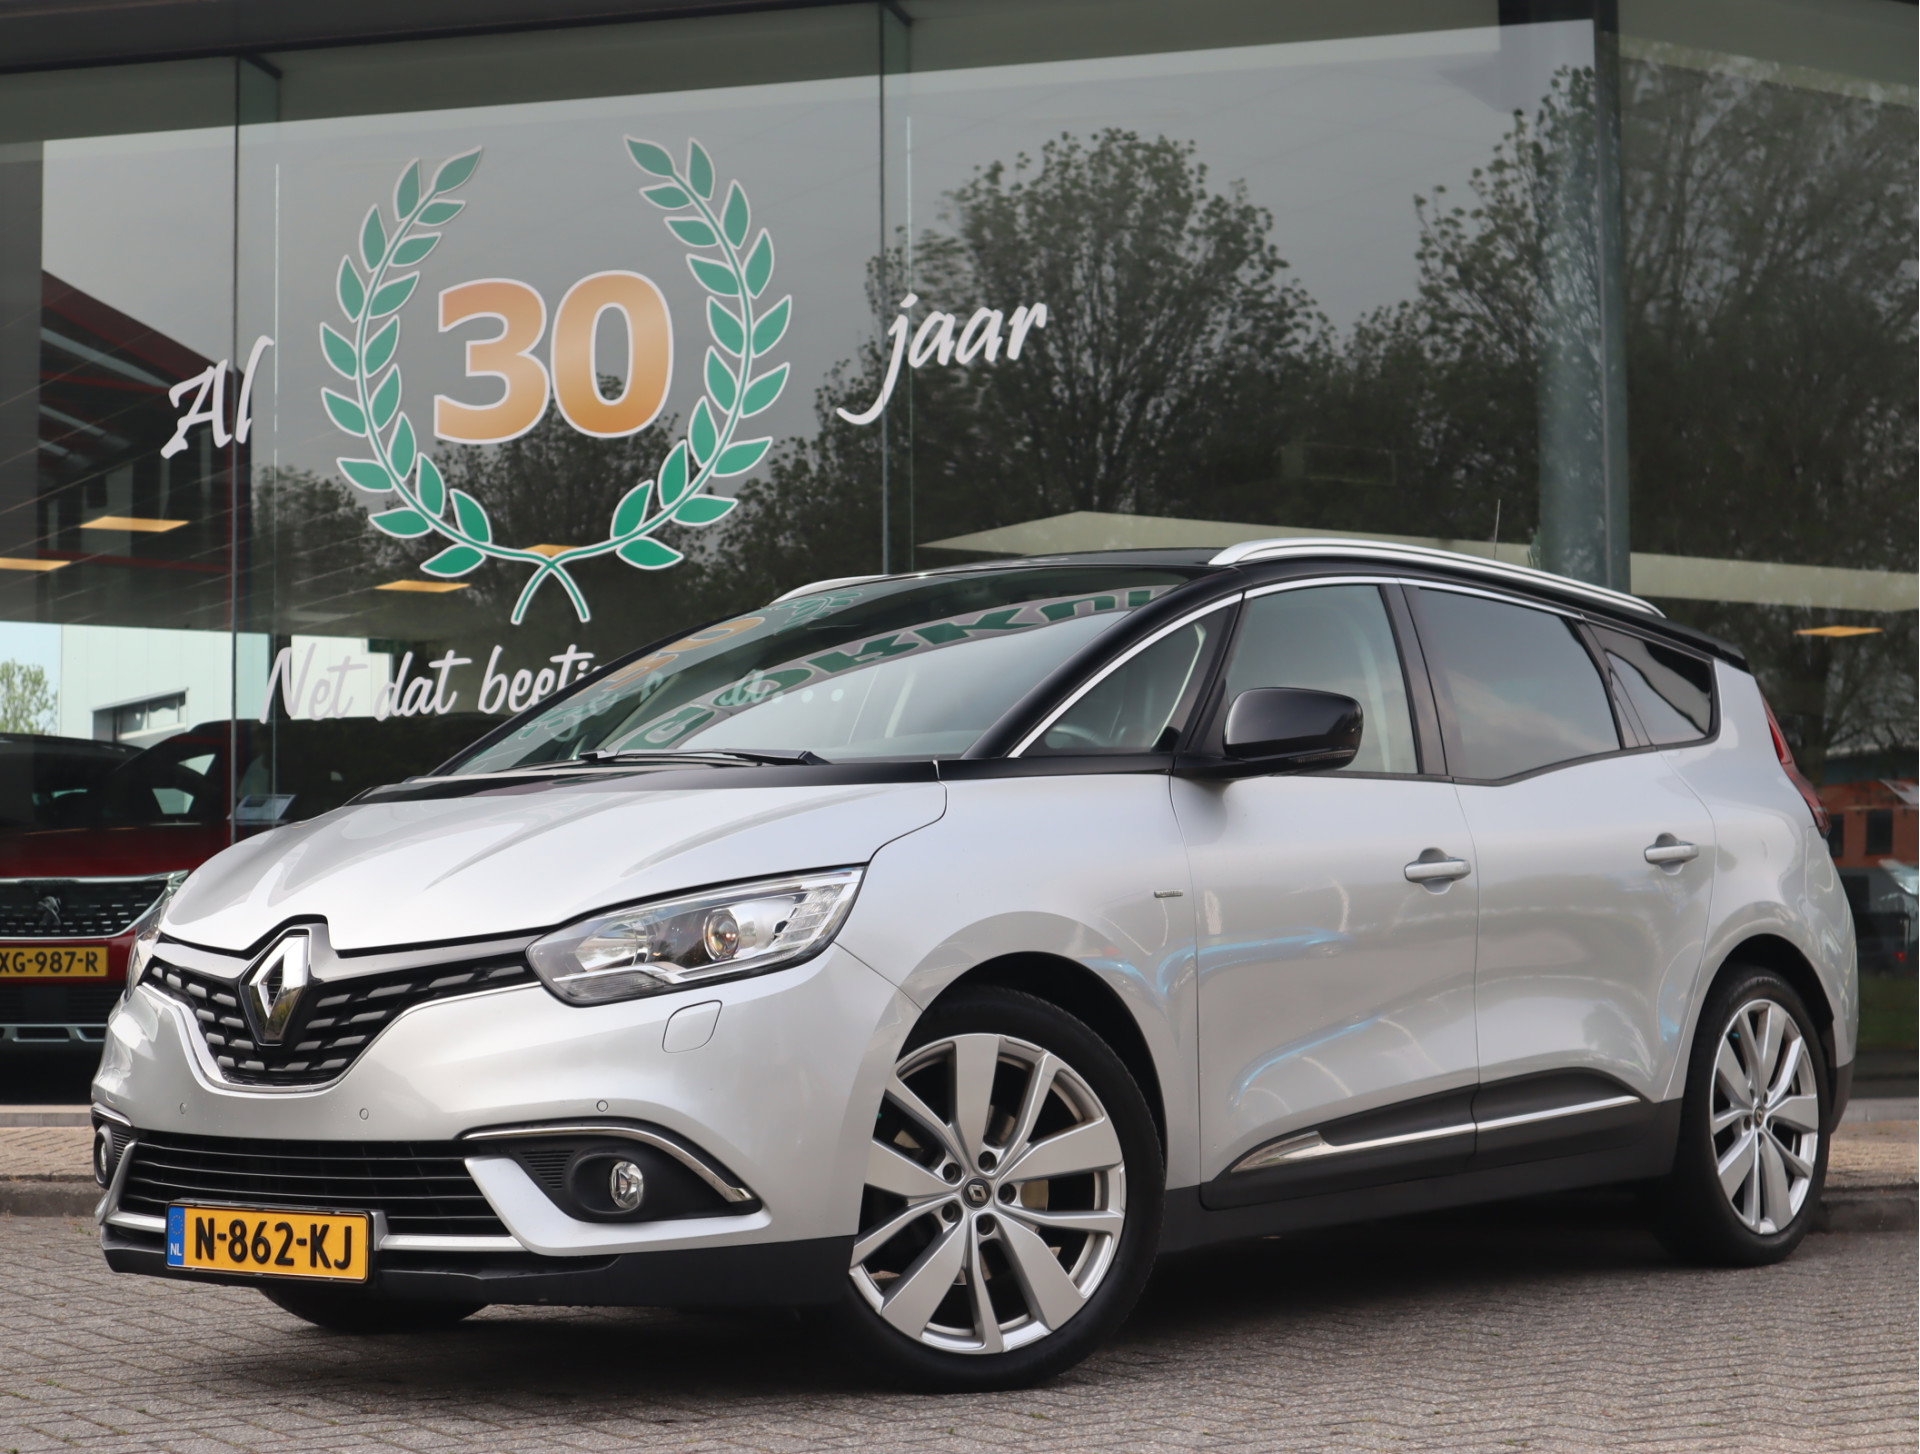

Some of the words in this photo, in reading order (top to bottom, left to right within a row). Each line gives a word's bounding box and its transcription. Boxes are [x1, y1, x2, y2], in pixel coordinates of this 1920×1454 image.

[160, 335, 275, 459] Al
[434, 269, 674, 445] 30
[836, 292, 1048, 426] jaar
[258, 642, 369, 725] Net
[374, 649, 473, 722] dat
[477, 643, 603, 715] beet
[0, 950, 98, 974] XG-987-R
[169, 1242, 183, 1257] NL
[195, 1216, 352, 1271] N-862-KJ
